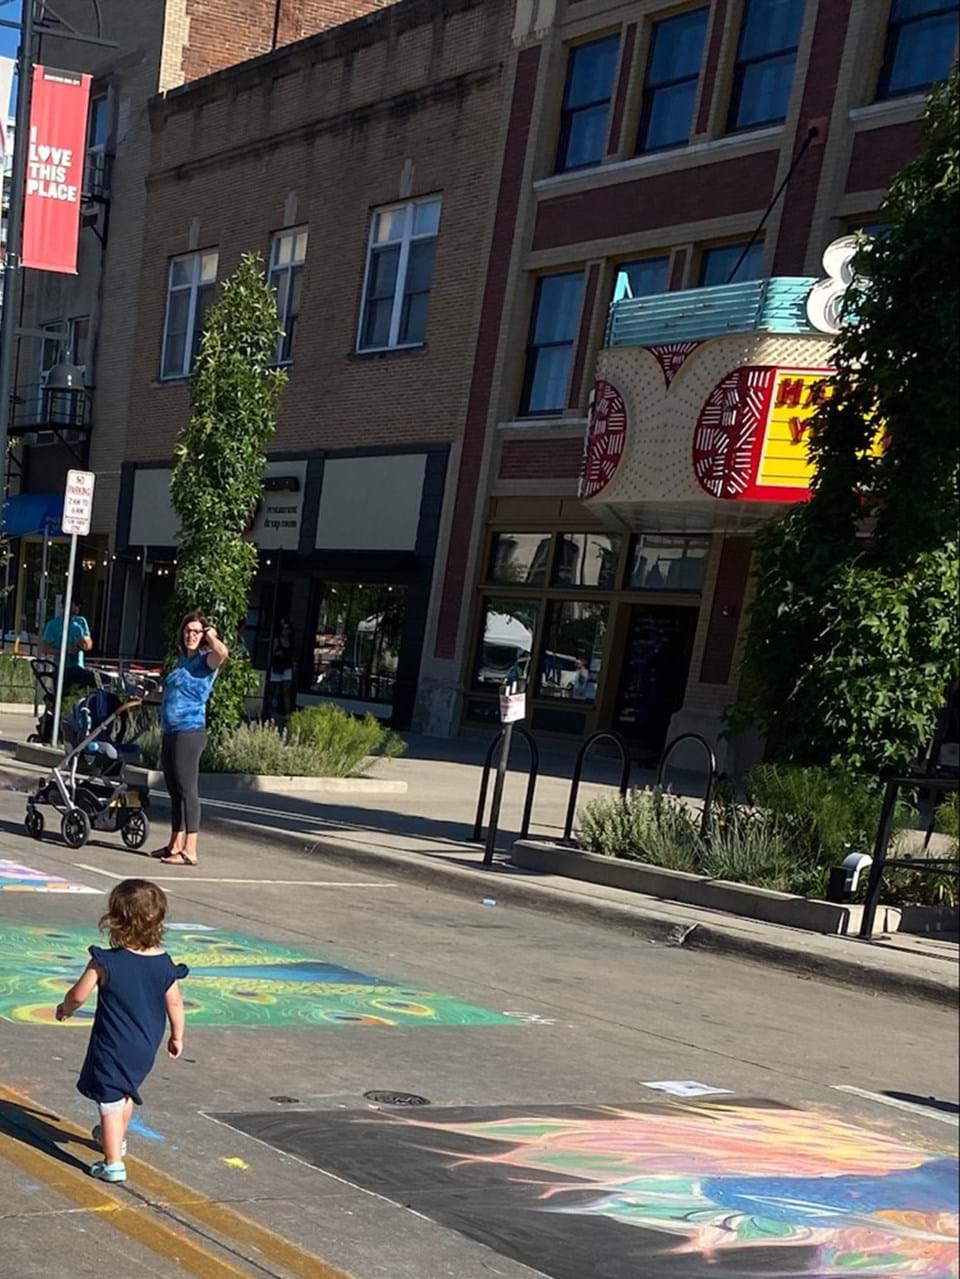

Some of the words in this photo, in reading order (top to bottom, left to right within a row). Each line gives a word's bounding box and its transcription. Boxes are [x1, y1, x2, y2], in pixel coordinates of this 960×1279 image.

[30, 126, 38, 142] I
[28, 163, 66, 183] THIS
[27, 180, 77, 202] PLACE
[76, 475, 86, 485] NO
[68, 485, 91, 497] PARKING
